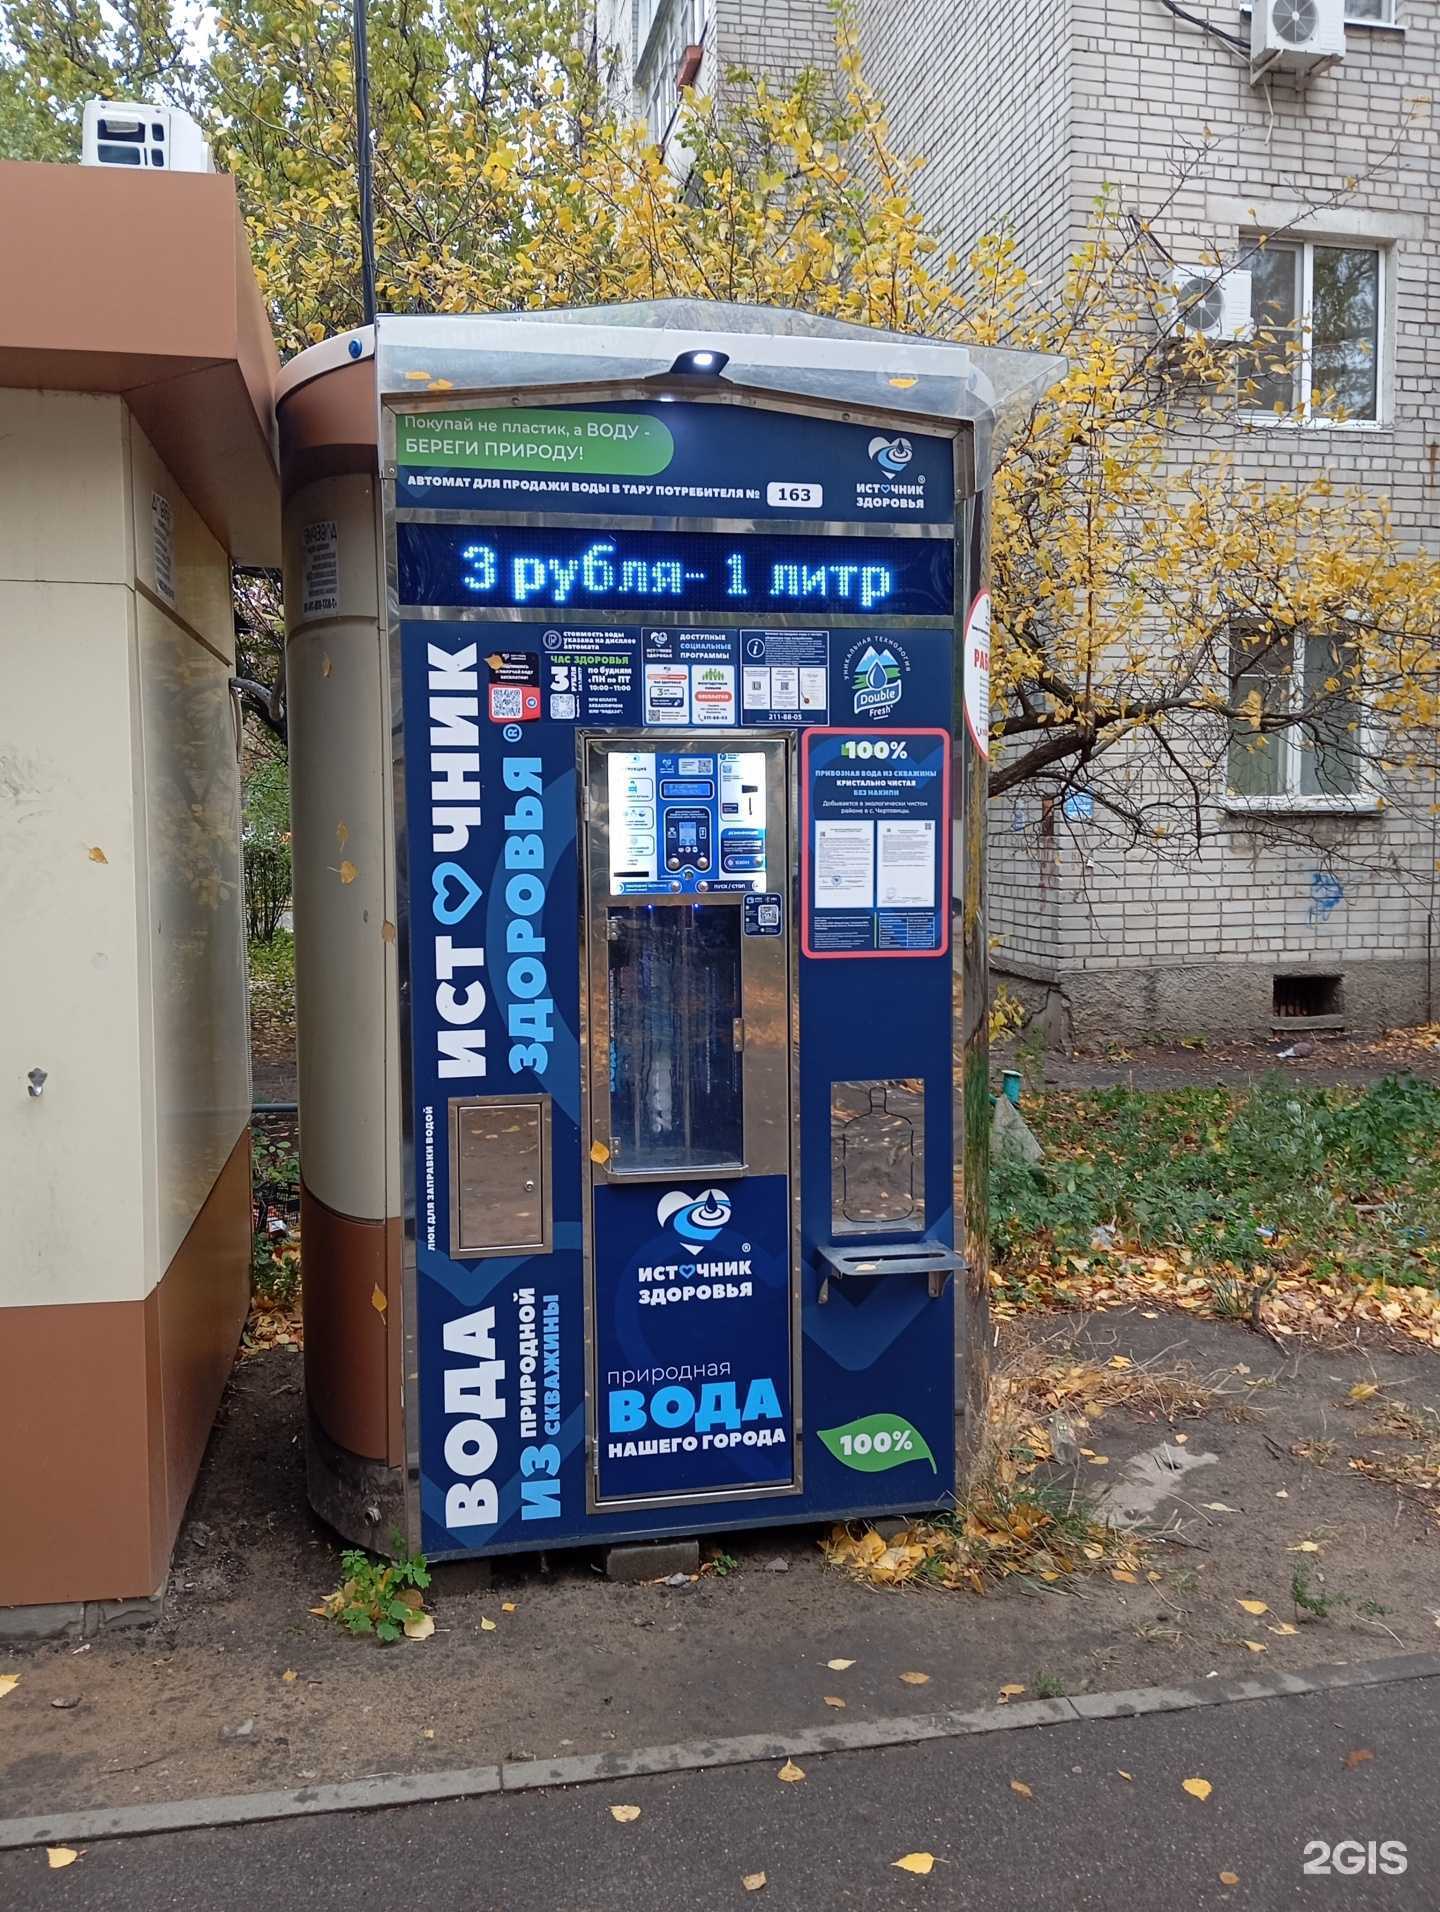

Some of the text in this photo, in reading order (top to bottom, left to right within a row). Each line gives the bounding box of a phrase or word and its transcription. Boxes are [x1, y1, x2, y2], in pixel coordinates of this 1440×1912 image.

[404, 415, 473, 432] Покупай
[478, 421, 497, 432] не
[502, 422, 570, 438] пластик,
[574, 426, 582, 436] а
[587, 422, 639, 440] ВОДУ
[405, 438, 584, 461] БЕРЕГИ ПРИРОДУ!
[408, 475, 761, 499] АВТОМАТ ДЛЯ ПРОДАЖИ ВОДЫ В ТАРУ ПОТРЕБИТЕЛЯ №
[778, 488, 811, 502] 163
[856, 497, 925, 510] ЗДОРОВЬЯ
[463, 545, 496, 590] 3
[727, 553, 748, 596] 1
[770, 563, 890, 606] литр
[550, 655, 629, 665] ЧАС ЗДОРОВЬЯ
[843, 637, 871, 680] УНИКАЛЬНАЯ
[875, 636, 911, 672] ТЕХНОЛОГИЯ
[550, 666, 569, 692] 3
[592, 675, 605, 683] ПН
[618, 675, 631, 683] ПТ
[860, 689, 896, 705] Double
[869, 705, 891, 717] Fresh
[846, 741, 908, 760] 100%
[503, 756, 554, 1075] ЗДОРОВЬЯ
[423, 1106, 436, 1251] ЛЮК ДЛЯ ЗАПРАВКИ ВОДОЙ
[638, 1282, 753, 1306] ЗДОРОВЬЯ
[542, 1294, 561, 1436] СКВАЖИНЫ
[607, 1361, 731, 1387] природная
[513, 1287, 561, 1521] ИЗ ПРИРОДНОЙ
[609, 1378, 783, 1433] ВОДА
[443, 1306, 506, 1529] ВОДА
[608, 1428, 786, 1458] НАШЕГО ГОРОДА
[839, 1430, 912, 1456] 100%
